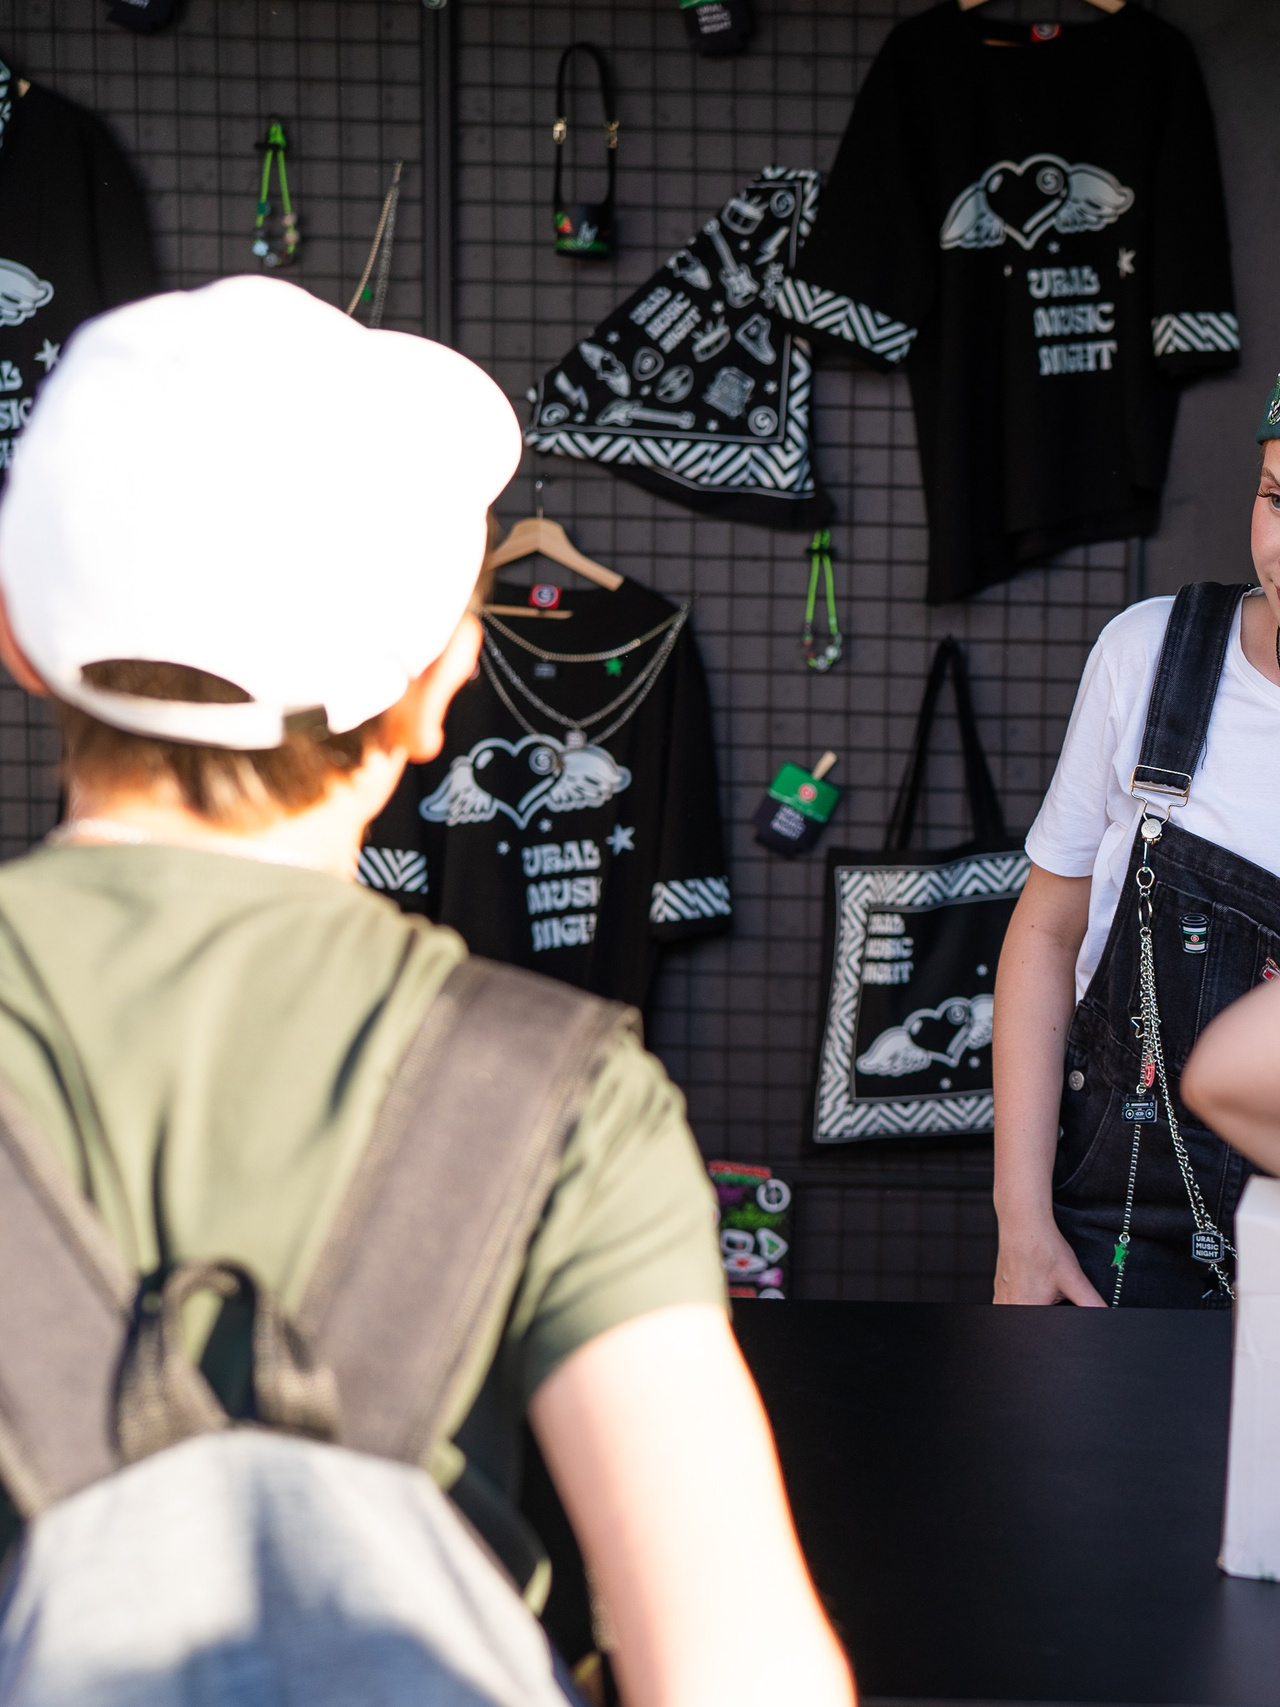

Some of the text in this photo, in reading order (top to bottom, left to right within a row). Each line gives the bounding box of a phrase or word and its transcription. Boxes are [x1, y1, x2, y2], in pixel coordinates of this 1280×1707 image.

[1027, 266, 1100, 299] URAL
[1033, 302, 1115, 337] MUSIC
[1038, 340, 1117, 376] NIGHT
[521, 839, 601, 877] URAL
[526, 876, 602, 915] MUSI
[1195, 1235, 1215, 1243] URAL
[1195, 1242, 1219, 1251] MUSIC
[1195, 1250, 1219, 1258] NIGHT
